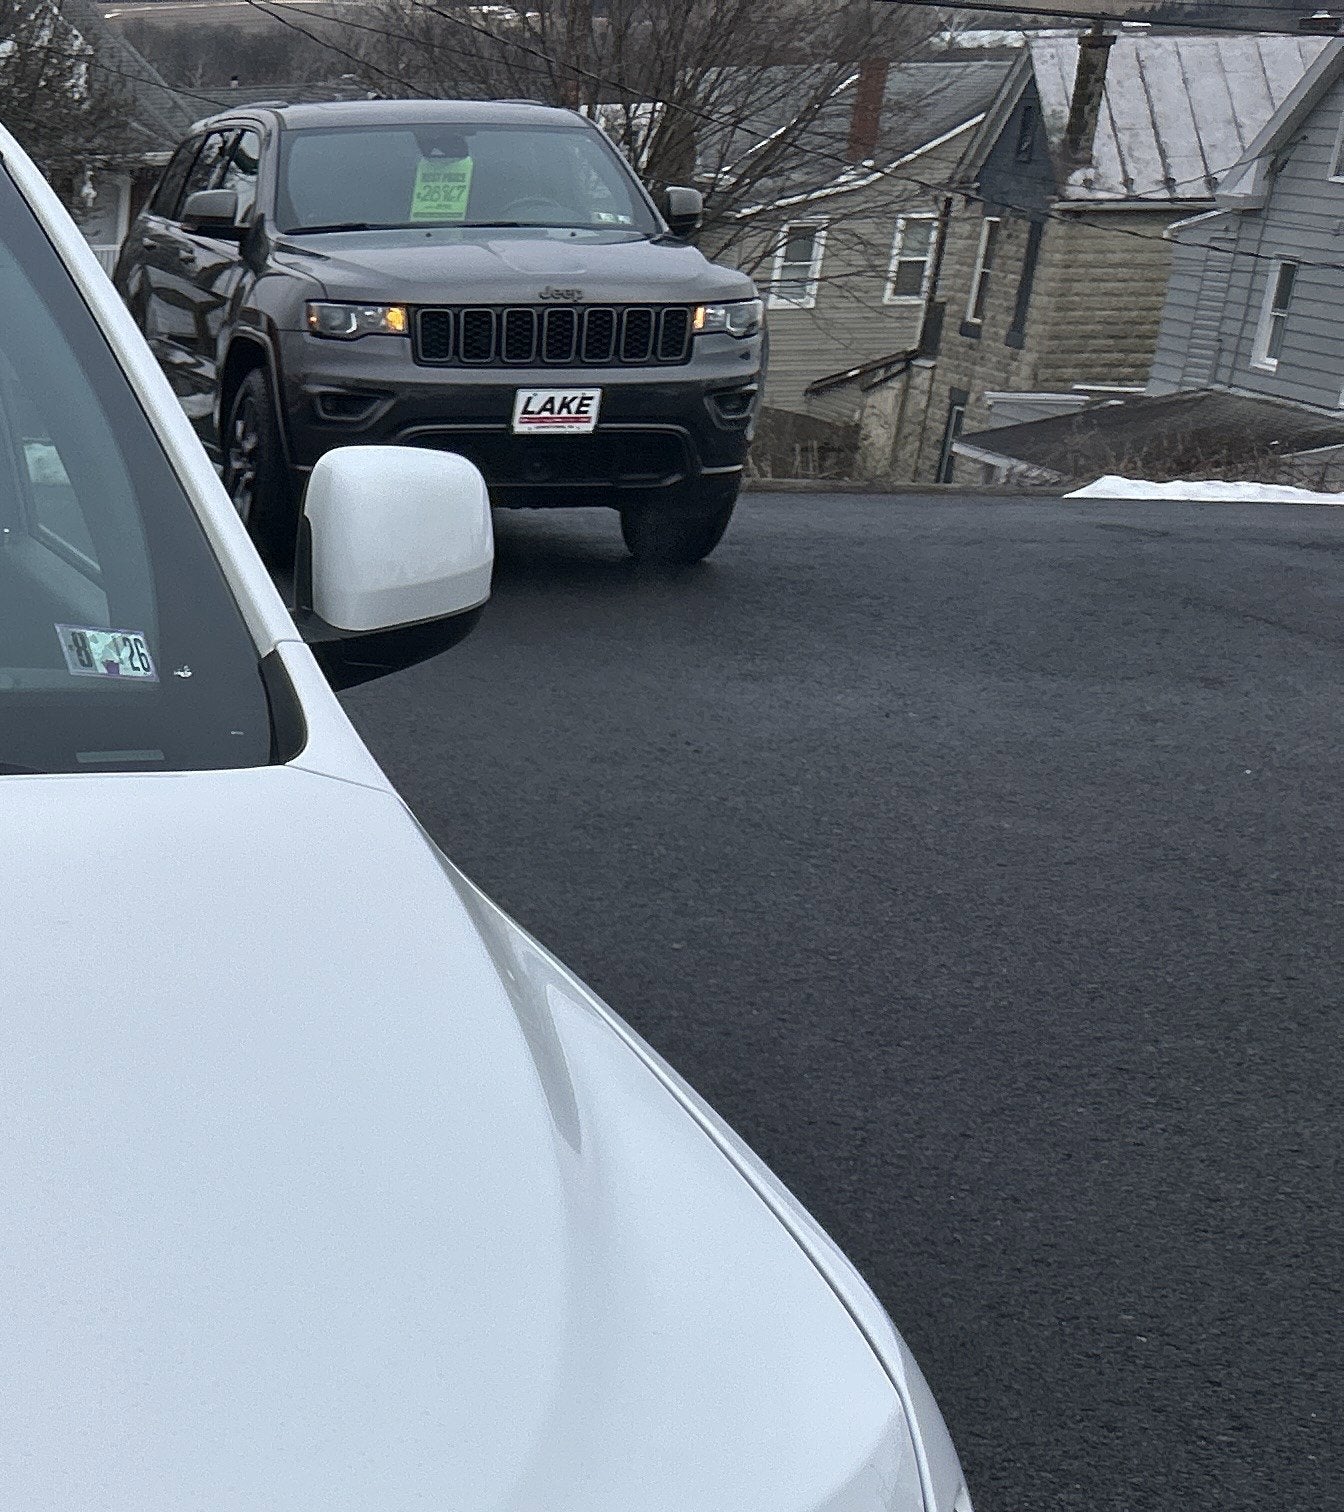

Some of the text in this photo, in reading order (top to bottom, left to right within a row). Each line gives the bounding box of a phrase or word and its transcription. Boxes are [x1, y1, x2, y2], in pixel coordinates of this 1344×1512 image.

[538, 286, 583, 303] Jeep
[521, 396, 594, 415] LAKE
[122, 637, 151, 673] 26
